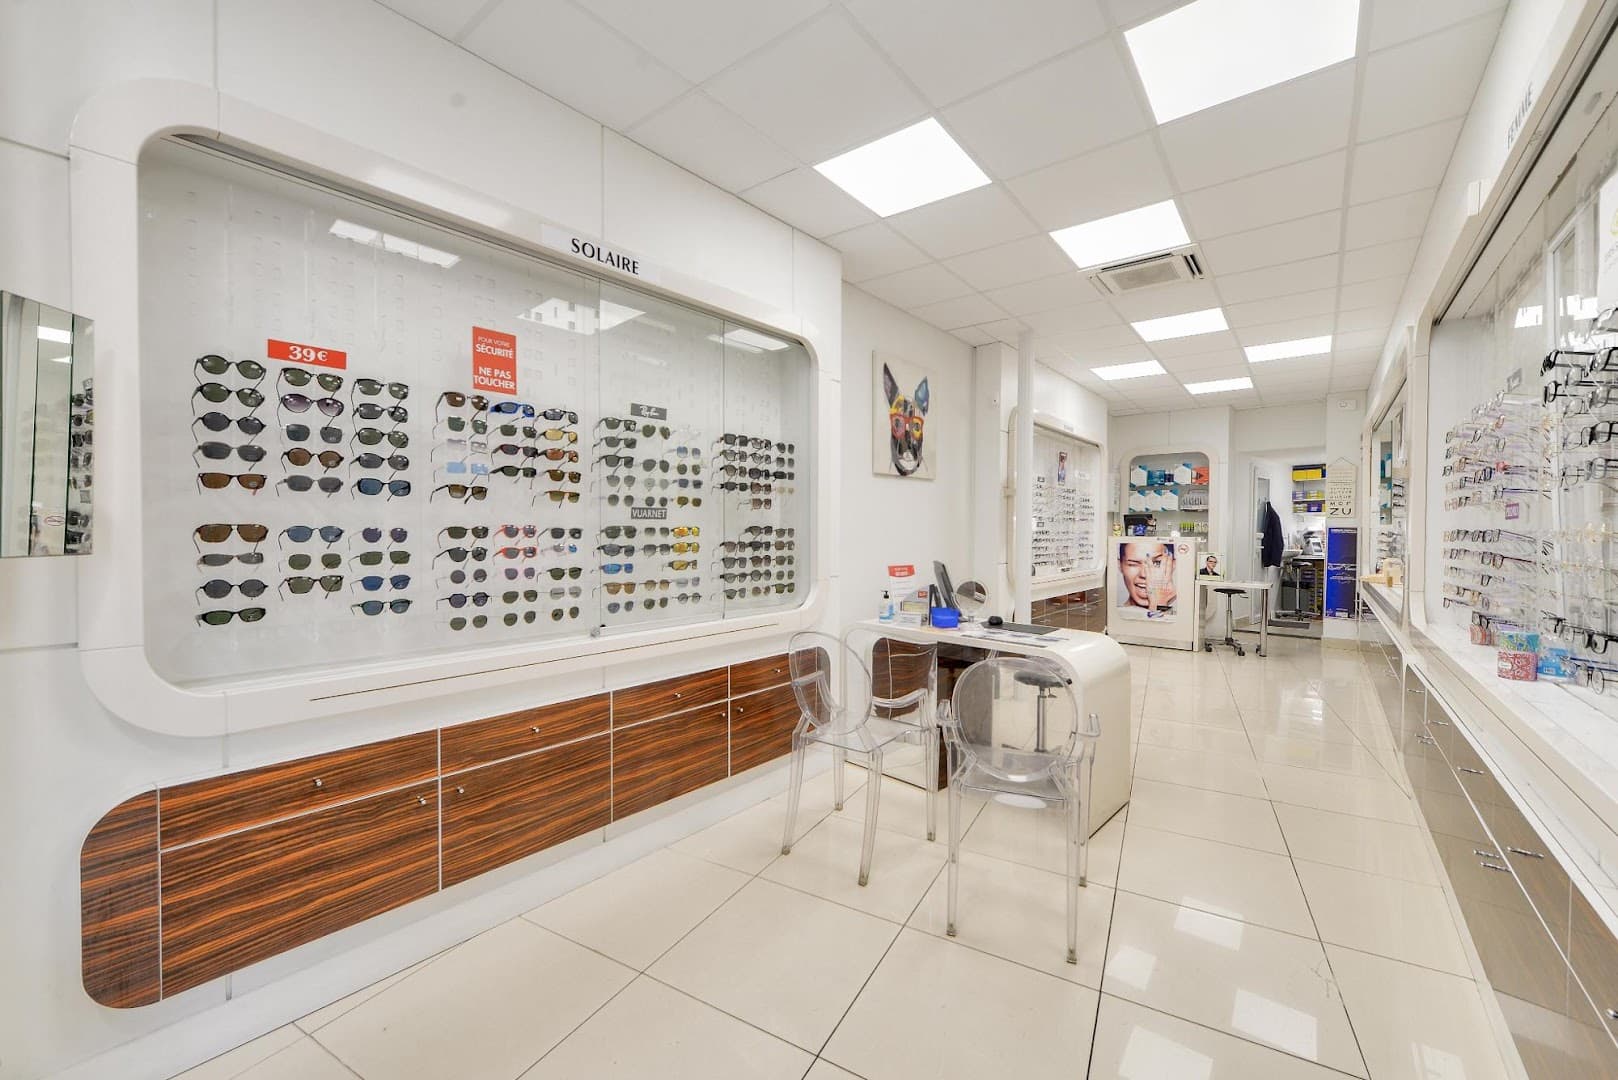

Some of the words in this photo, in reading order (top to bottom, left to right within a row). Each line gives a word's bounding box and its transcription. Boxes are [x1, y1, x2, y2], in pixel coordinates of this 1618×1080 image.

[571, 238, 639, 275] SOLAIRE
[288, 345, 329, 362] 39€
[475, 343, 513, 359] SÉCURITÉ
[478, 366, 492, 376] NE
[494, 369, 512, 379] PAS
[473, 375, 516, 390] TOUCHER
[632, 508, 667, 518] VUARNET
